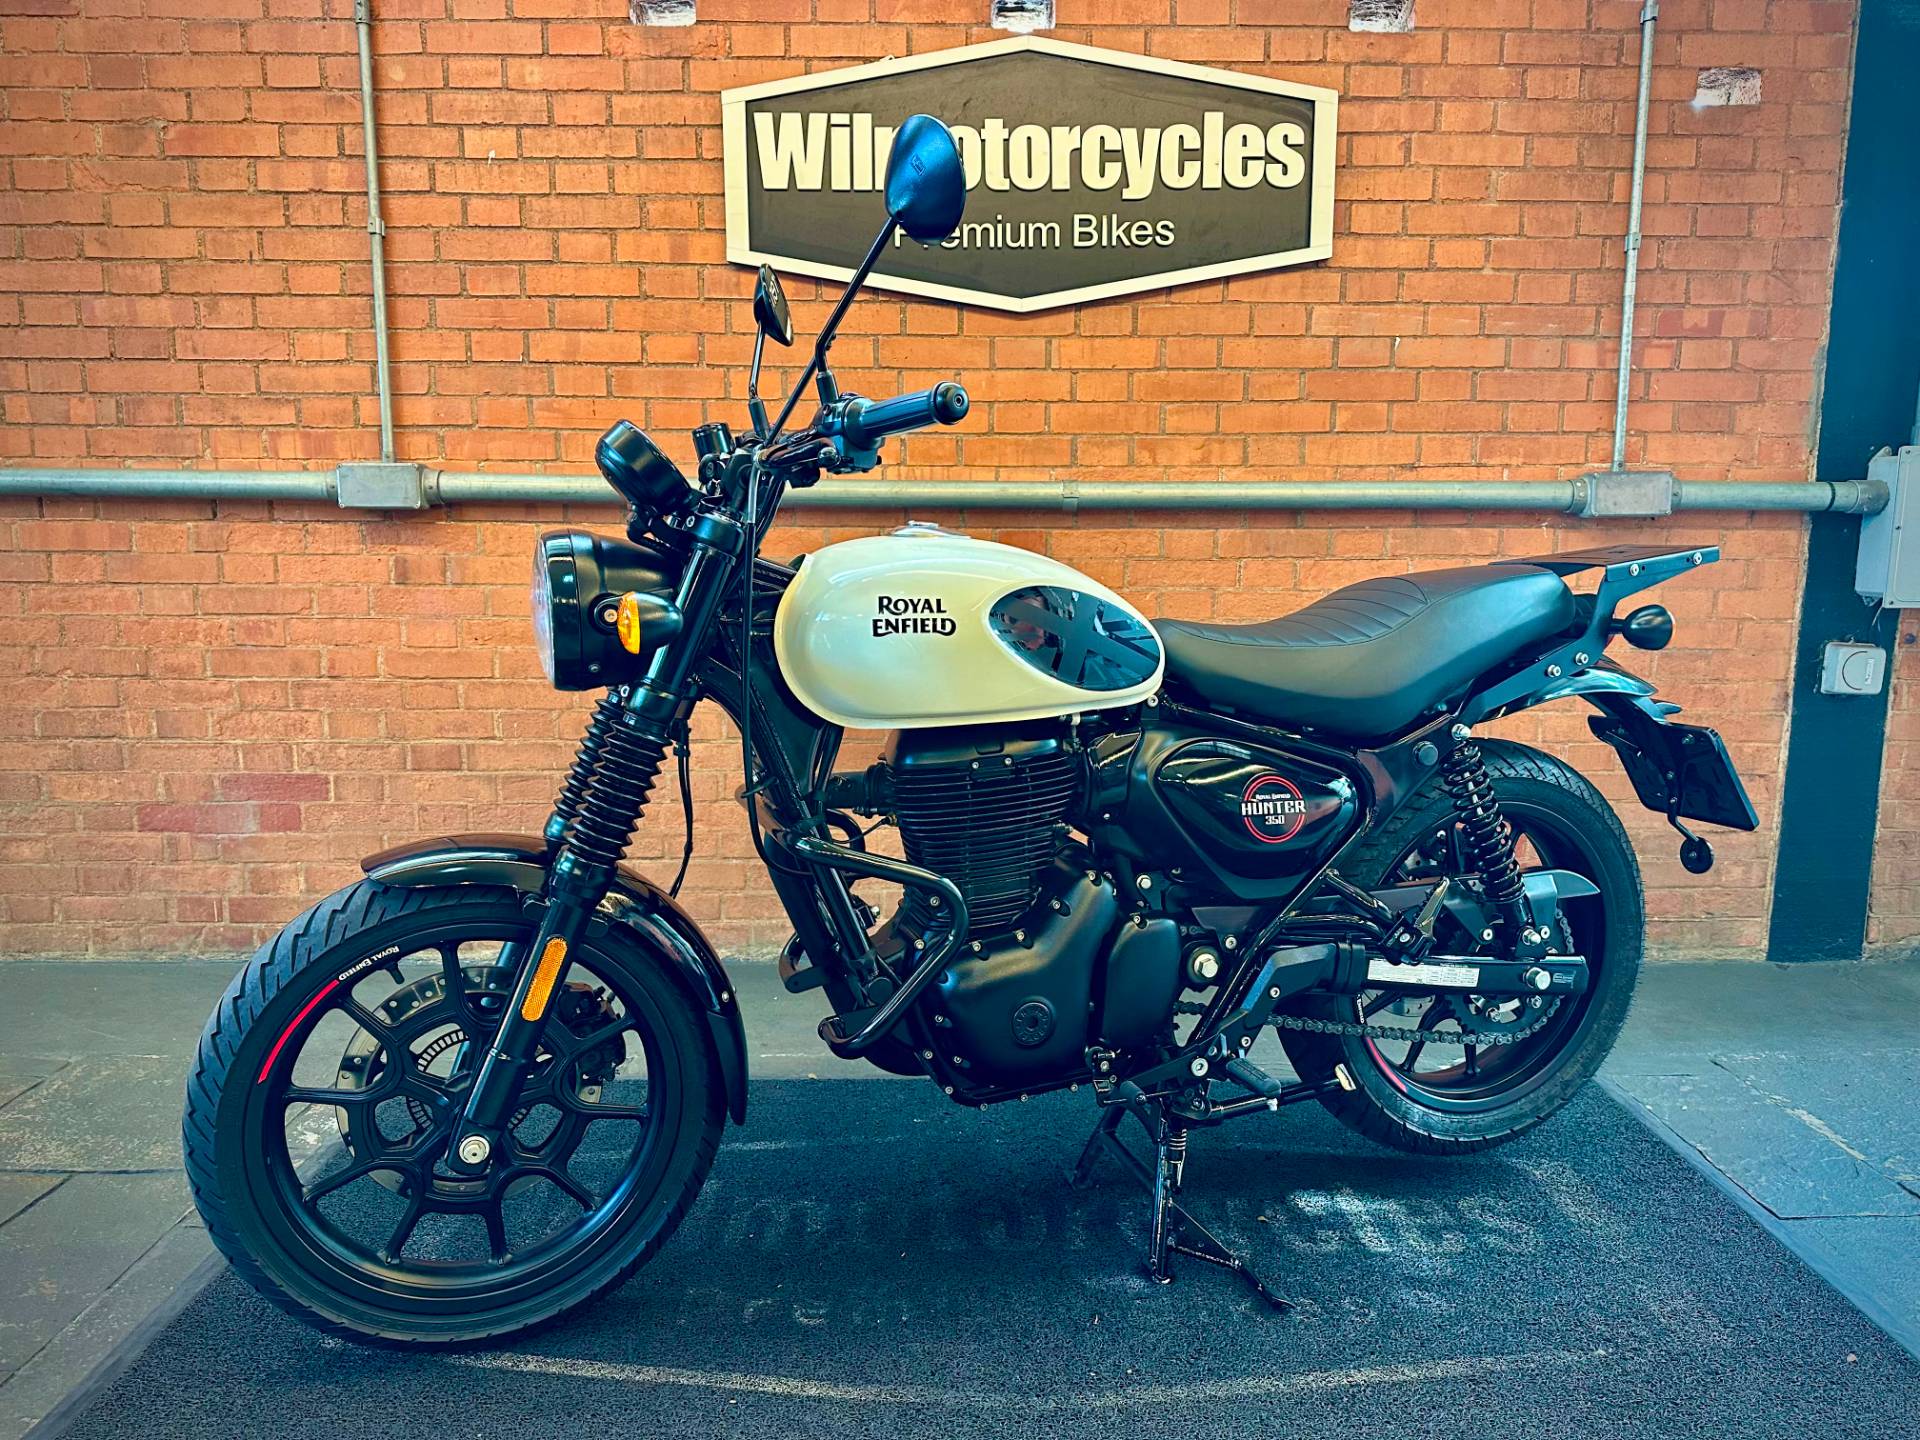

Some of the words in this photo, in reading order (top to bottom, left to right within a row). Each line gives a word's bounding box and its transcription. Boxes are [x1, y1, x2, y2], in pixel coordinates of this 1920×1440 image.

[753, 112, 1306, 200] Wilotorcycles
[878, 595, 947, 616] ROYAL
[872, 617, 957, 637] ENFIELD
[1241, 800, 1306, 816] HUNTER
[1265, 814, 1285, 825] 350
[370, 945, 400, 961] ROYAL
[338, 958, 373, 981] ENFIELD
